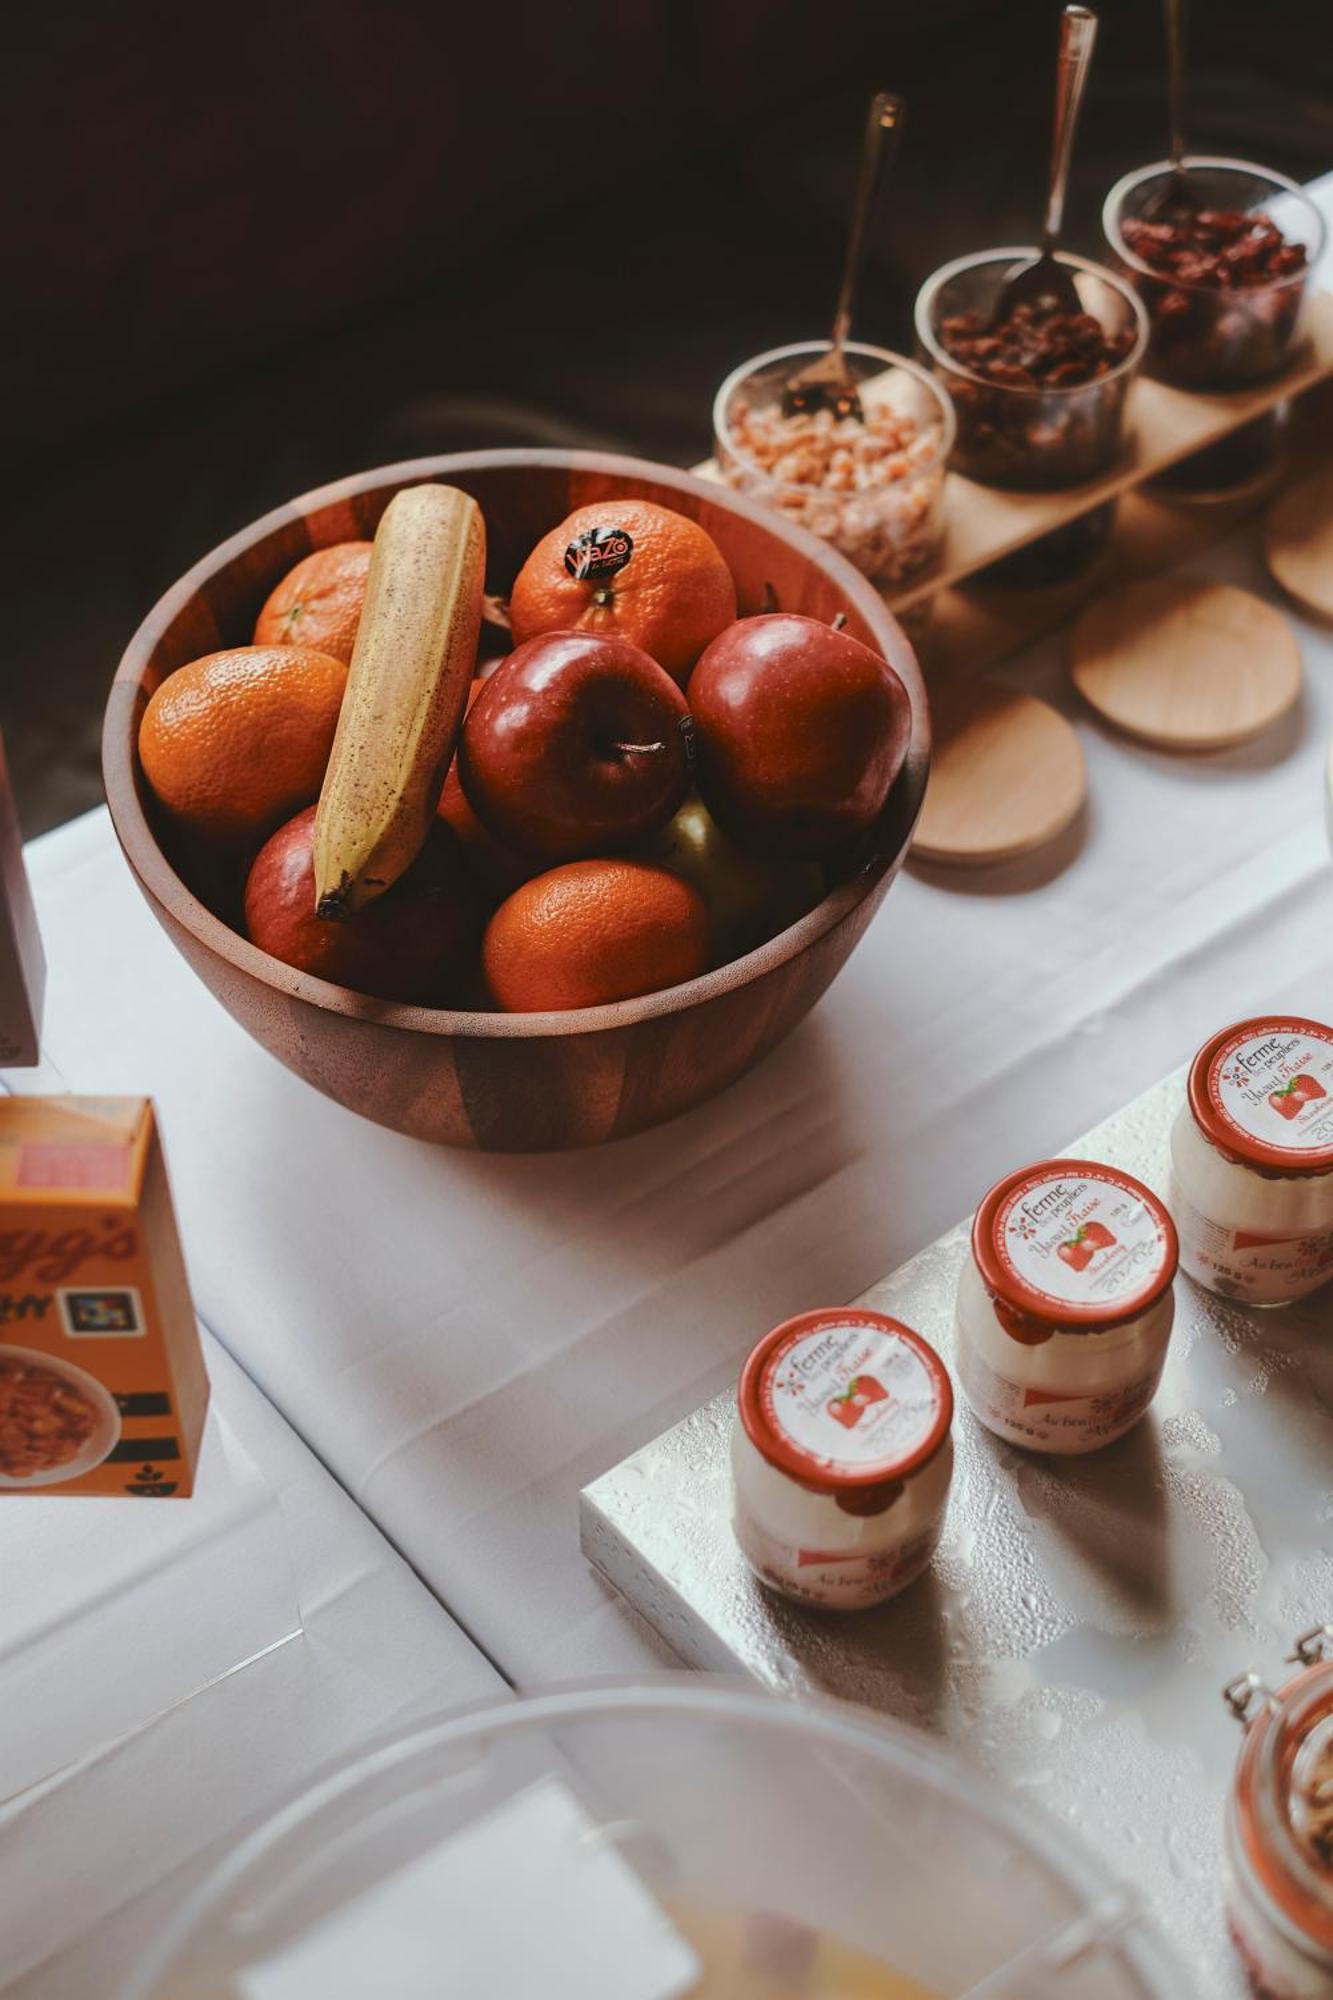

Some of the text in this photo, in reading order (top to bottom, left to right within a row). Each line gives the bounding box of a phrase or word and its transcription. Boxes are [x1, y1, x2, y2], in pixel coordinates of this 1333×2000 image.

[1235, 1037, 1281, 1075] ferme
[1021, 1184, 1068, 1223] ferme
[791, 1336, 838, 1375] ferme
